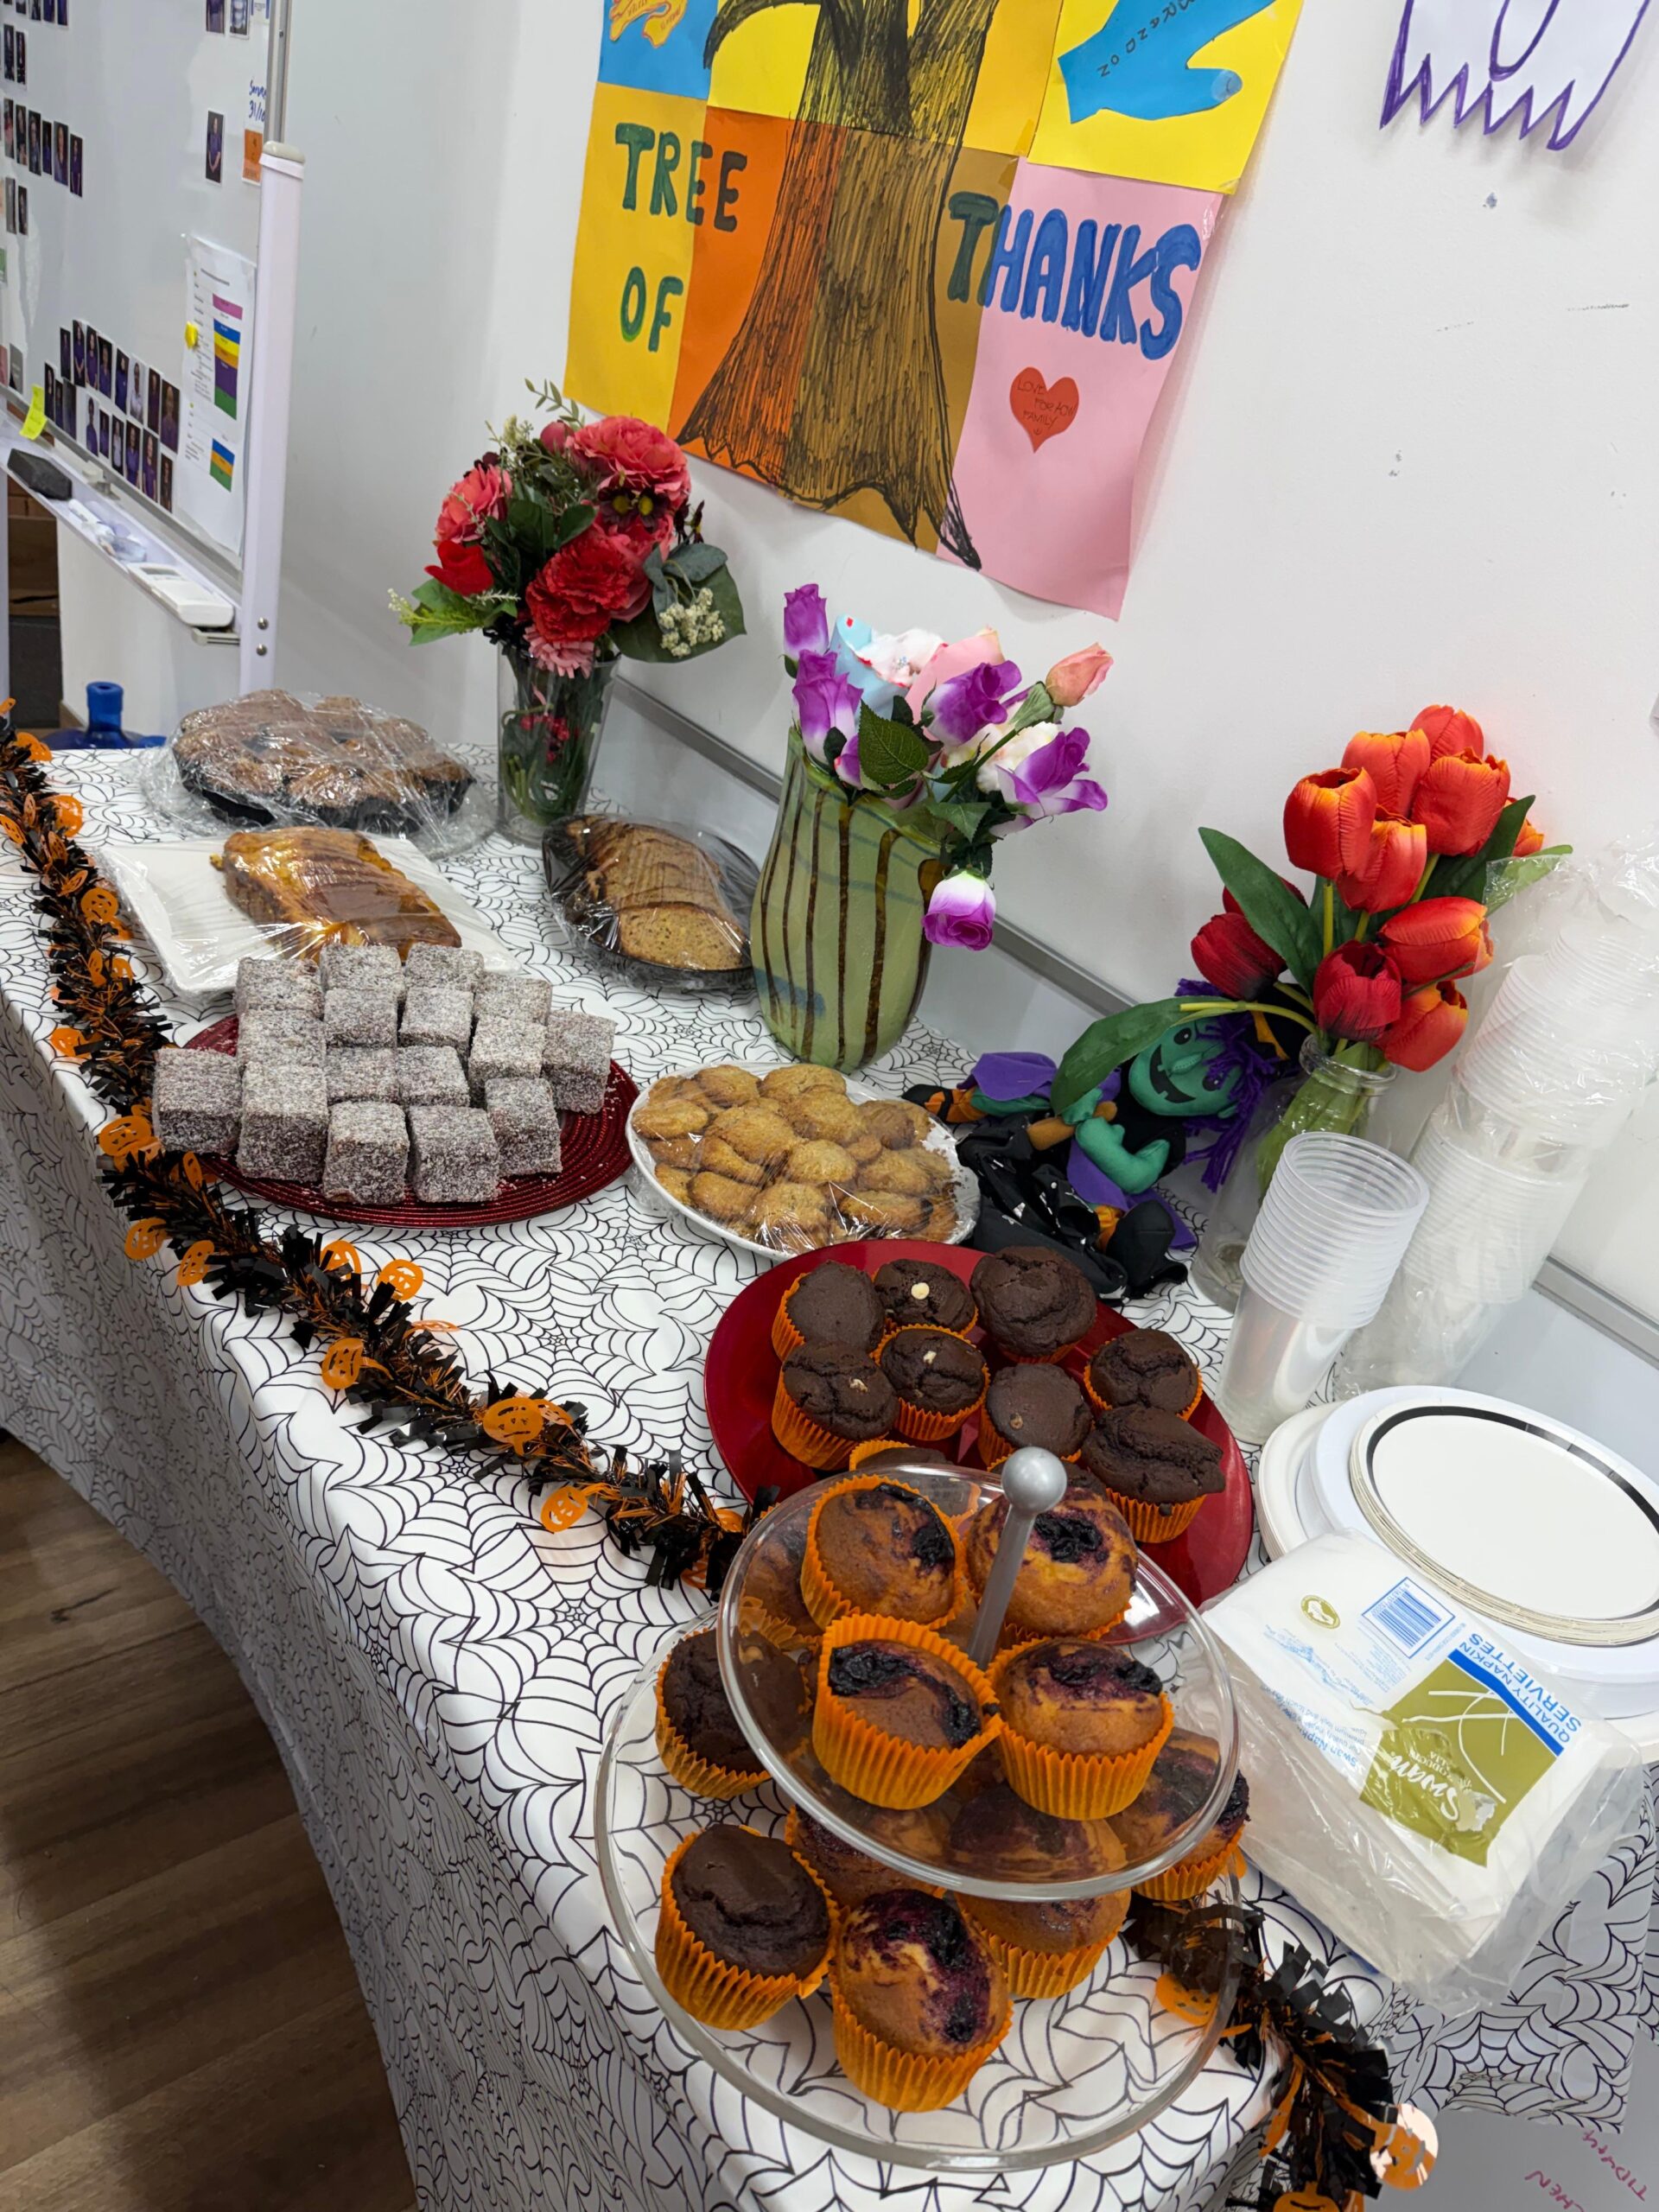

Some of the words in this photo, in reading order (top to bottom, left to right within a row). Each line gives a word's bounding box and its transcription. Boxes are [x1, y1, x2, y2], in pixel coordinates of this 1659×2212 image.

[614, 122, 748, 233] TREE
[620, 264, 684, 353] OF
[947, 190, 1201, 361] THANKS
[1023, 410, 1058, 430] FAMILY
[1459, 1642, 1512, 1685] NAPKIN
[1469, 1633, 1582, 1732] SERVIETTES
[1512, 1688, 1570, 1743] QUALITY
[1330, 1746, 1358, 1767] Swan
[1389, 1755, 1459, 1821] Swan
